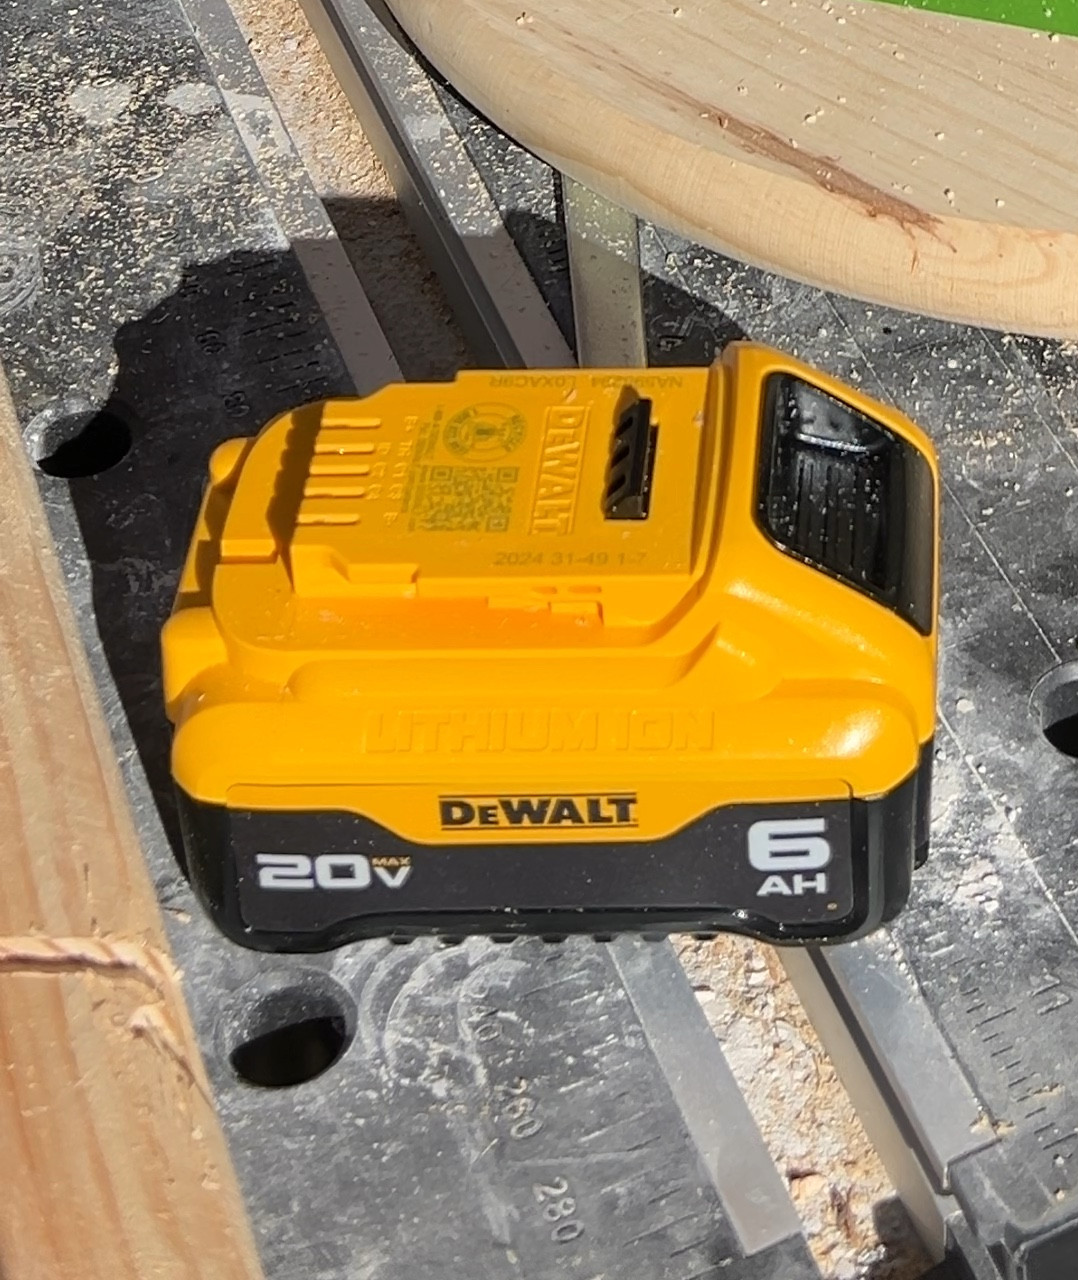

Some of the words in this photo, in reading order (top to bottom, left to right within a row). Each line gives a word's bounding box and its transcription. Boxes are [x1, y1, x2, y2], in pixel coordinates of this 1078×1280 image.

[363, 708, 600, 754] LITHIUM
[615, 708, 716, 752] ION
[747, 817, 831, 872] 6
[256, 853, 413, 889] 20V
[371, 856, 411, 867] MAX
[756, 872, 827, 897] AH
[533, 1175, 586, 1243] 280
